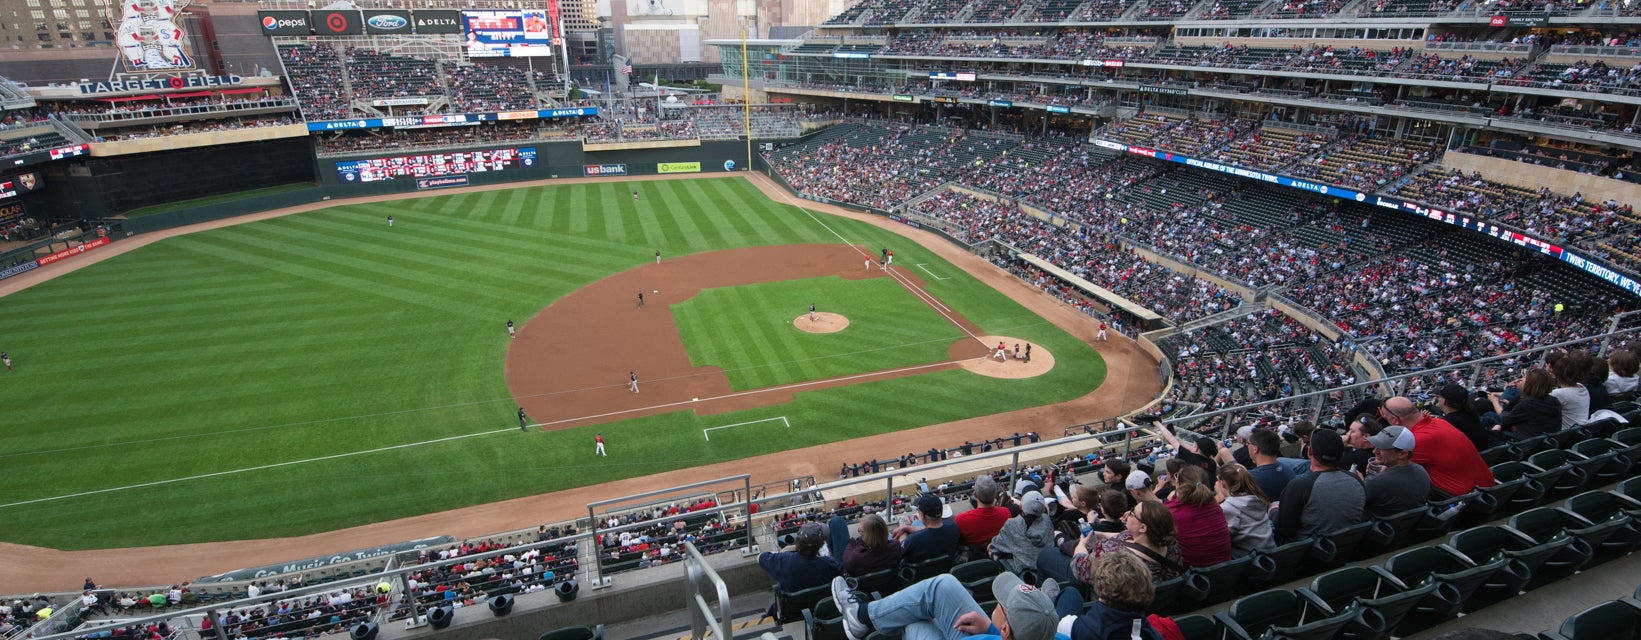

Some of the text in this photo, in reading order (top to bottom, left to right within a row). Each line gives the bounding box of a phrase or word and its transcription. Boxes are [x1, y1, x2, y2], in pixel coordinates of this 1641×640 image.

[278, 17, 306, 28] pepsi
[376, 19, 399, 28] Ford
[427, 18, 457, 26] DELTA
[83, 75, 243, 93] TARGET FIELD
[1186, 158, 1278, 183] OFFICIAL AIRLINE OF THE MINNESOTA TWINS.
[1298, 182, 1318, 190] DELTA
[58, 251, 69, 259] MORE
[69, 247, 79, 255] KIDS
[1566, 252, 1640, 294] TWINS TERRITORY, WE'VE
[255, 569, 277, 578] Go
[330, 555, 351, 564] Go
